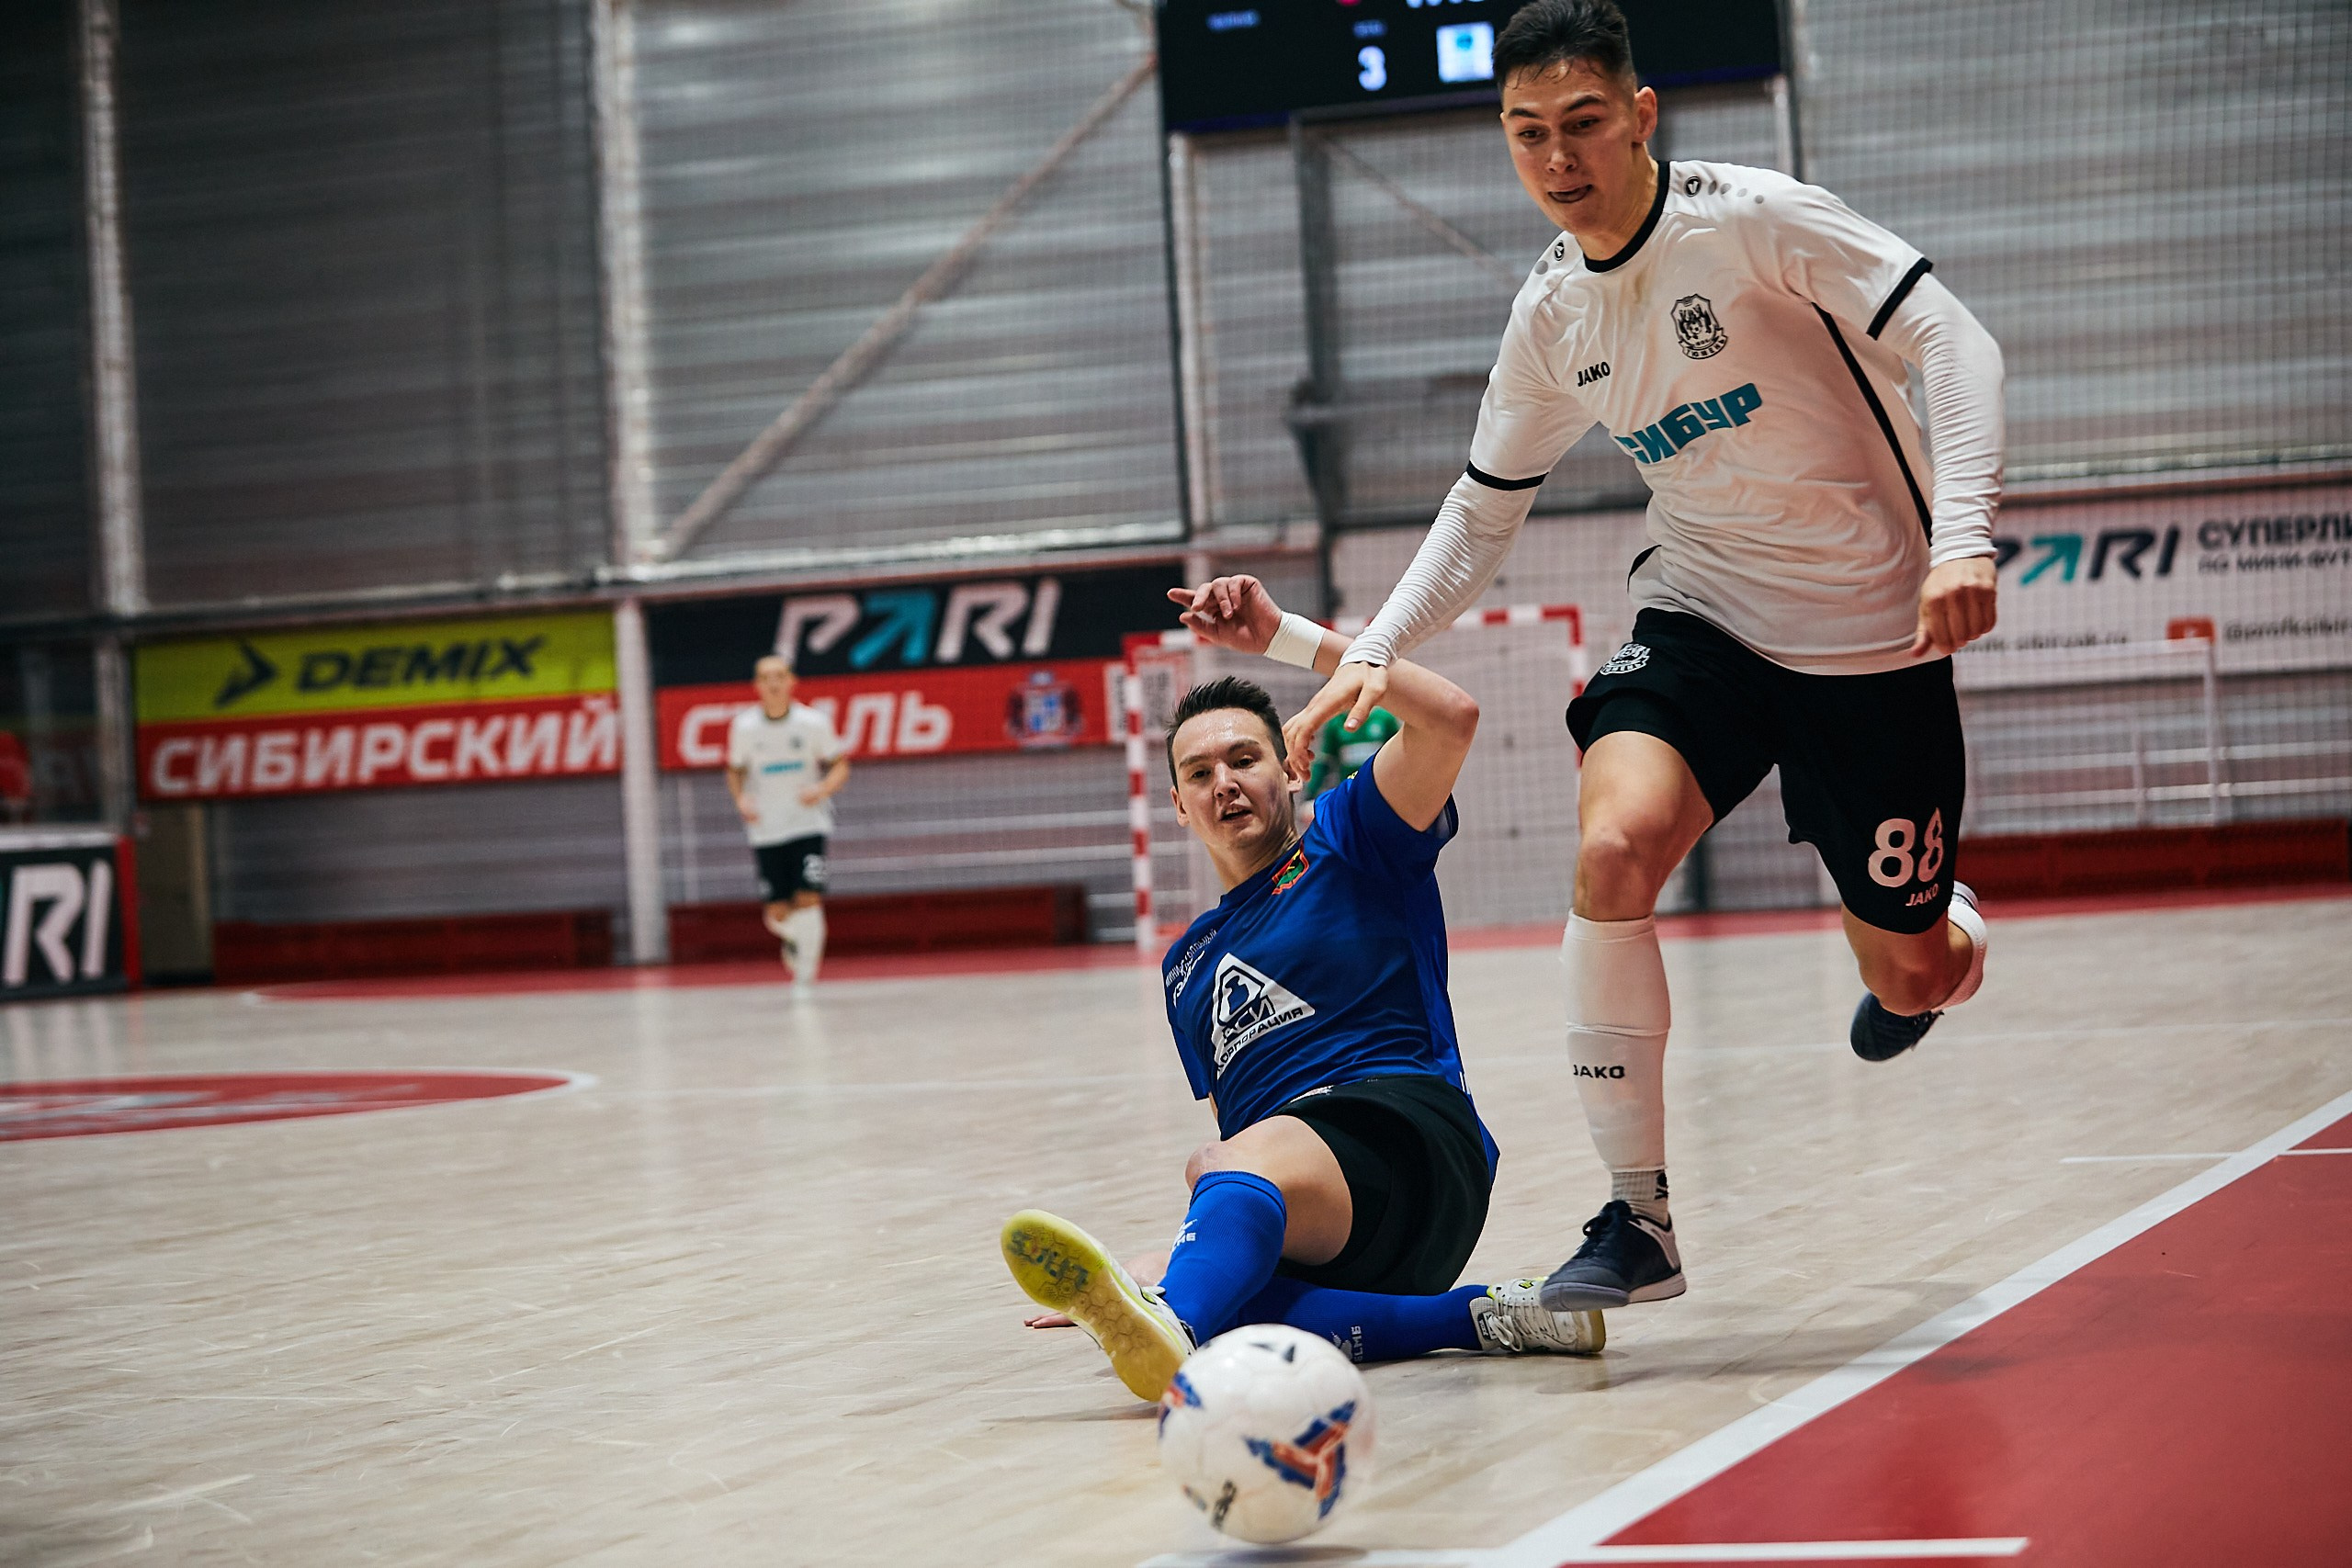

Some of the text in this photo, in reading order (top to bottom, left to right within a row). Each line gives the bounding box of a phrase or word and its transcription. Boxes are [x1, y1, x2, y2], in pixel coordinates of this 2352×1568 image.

[1358, 46, 1386, 91] 3
[1577, 361, 1610, 387] JAKO
[774, 577, 1062, 669] PARI
[295, 636, 546, 693] DEMIX
[151, 695, 620, 795] СИБИРСКИЙ
[677, 690, 953, 765] СЛЬ
[0, 860, 113, 985] RI
[1905, 883, 1939, 907] JAKO
[1573, 1064, 1625, 1079] JAKO
